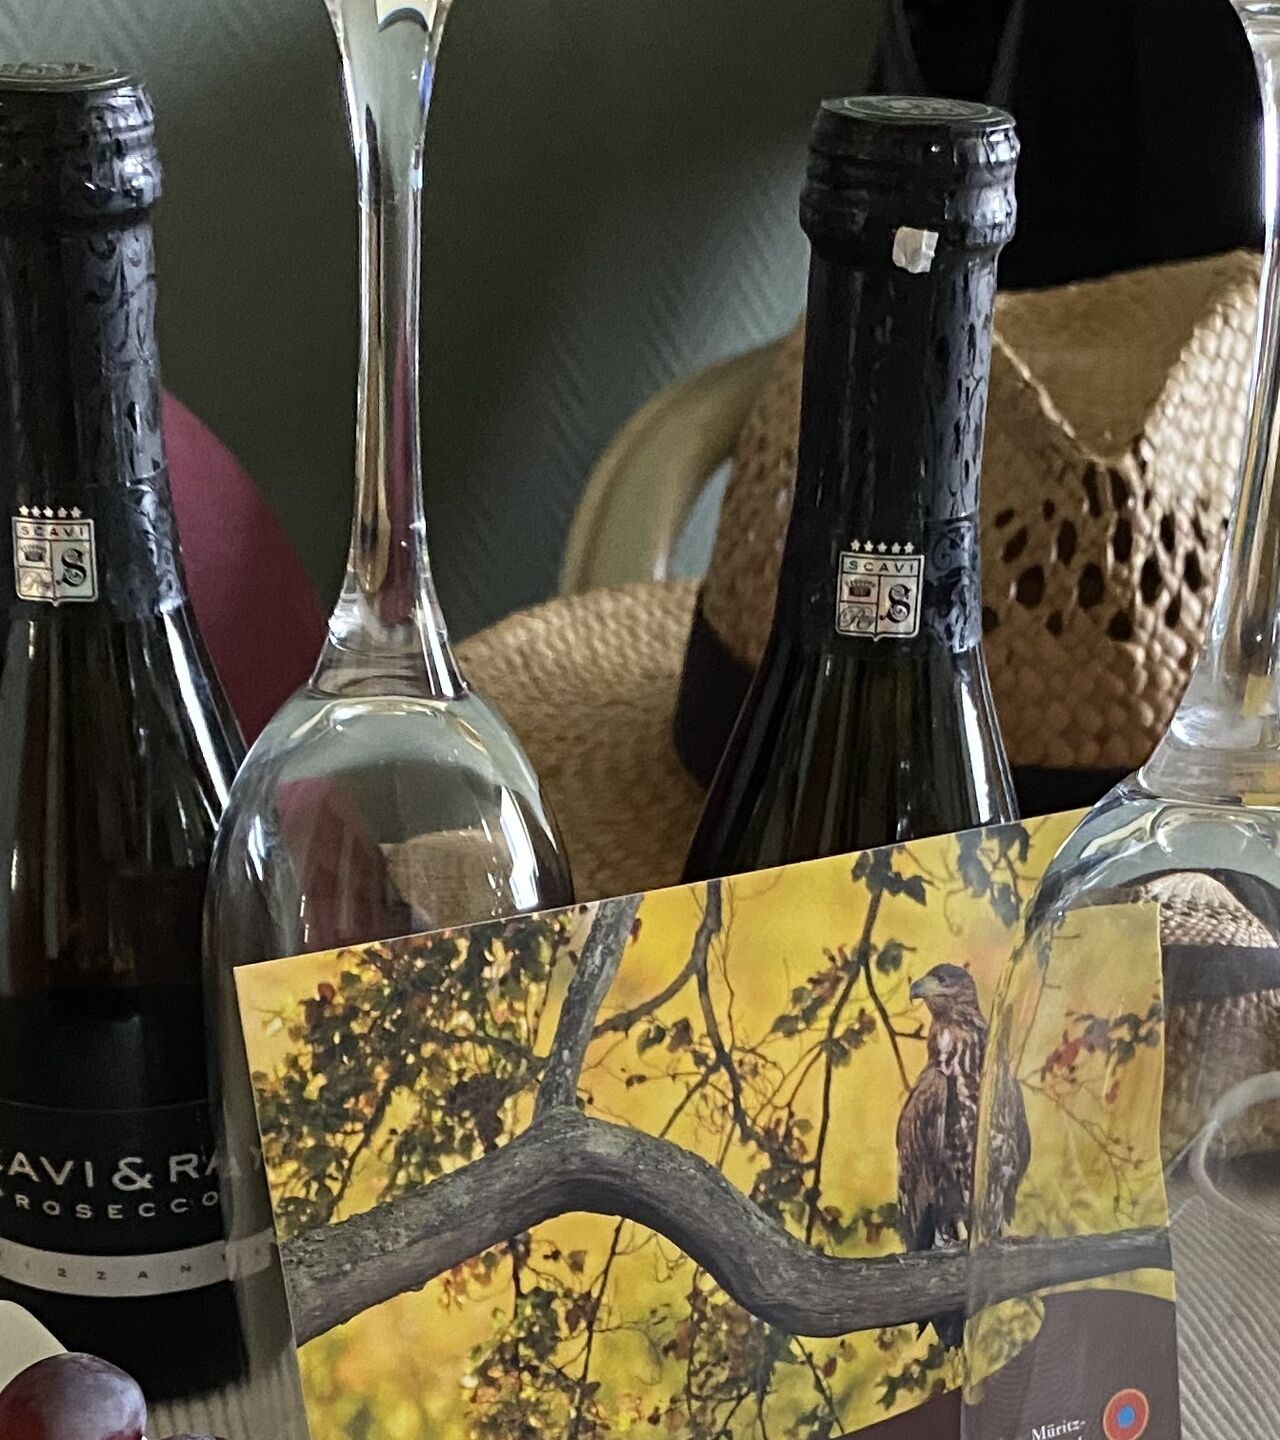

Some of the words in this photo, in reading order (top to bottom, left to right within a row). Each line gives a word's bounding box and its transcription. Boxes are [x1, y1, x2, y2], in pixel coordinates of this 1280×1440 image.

[20, 525, 84, 538] SCAVI
[848, 560, 914, 573] SCAVI
[111, 1156, 153, 1191] &
